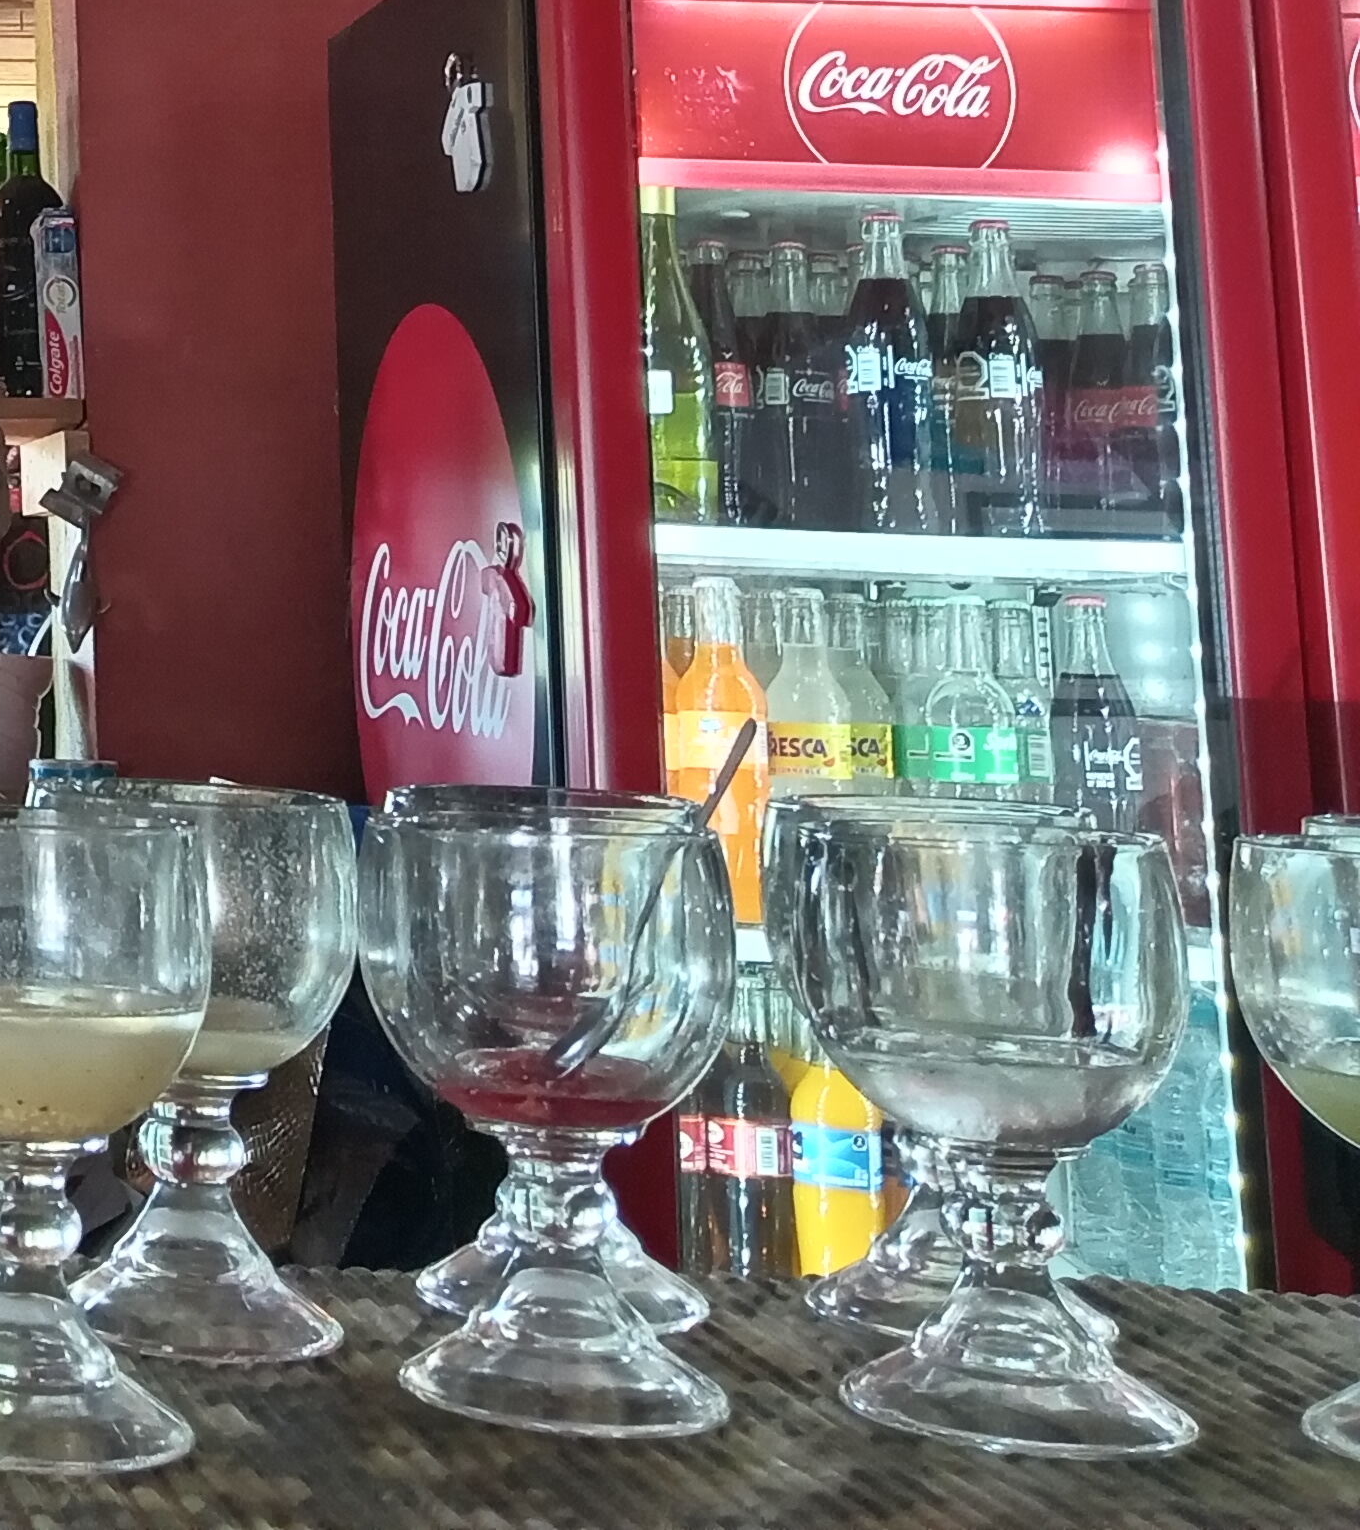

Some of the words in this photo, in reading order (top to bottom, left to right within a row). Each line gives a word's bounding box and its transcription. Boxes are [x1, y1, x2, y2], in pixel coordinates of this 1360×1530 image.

[797, 50, 1002, 118] Coca-Cola
[49, 328, 65, 396] Colgate
[360, 541, 513, 741] Coca-Cola
[768, 736, 829, 760] RESCA
